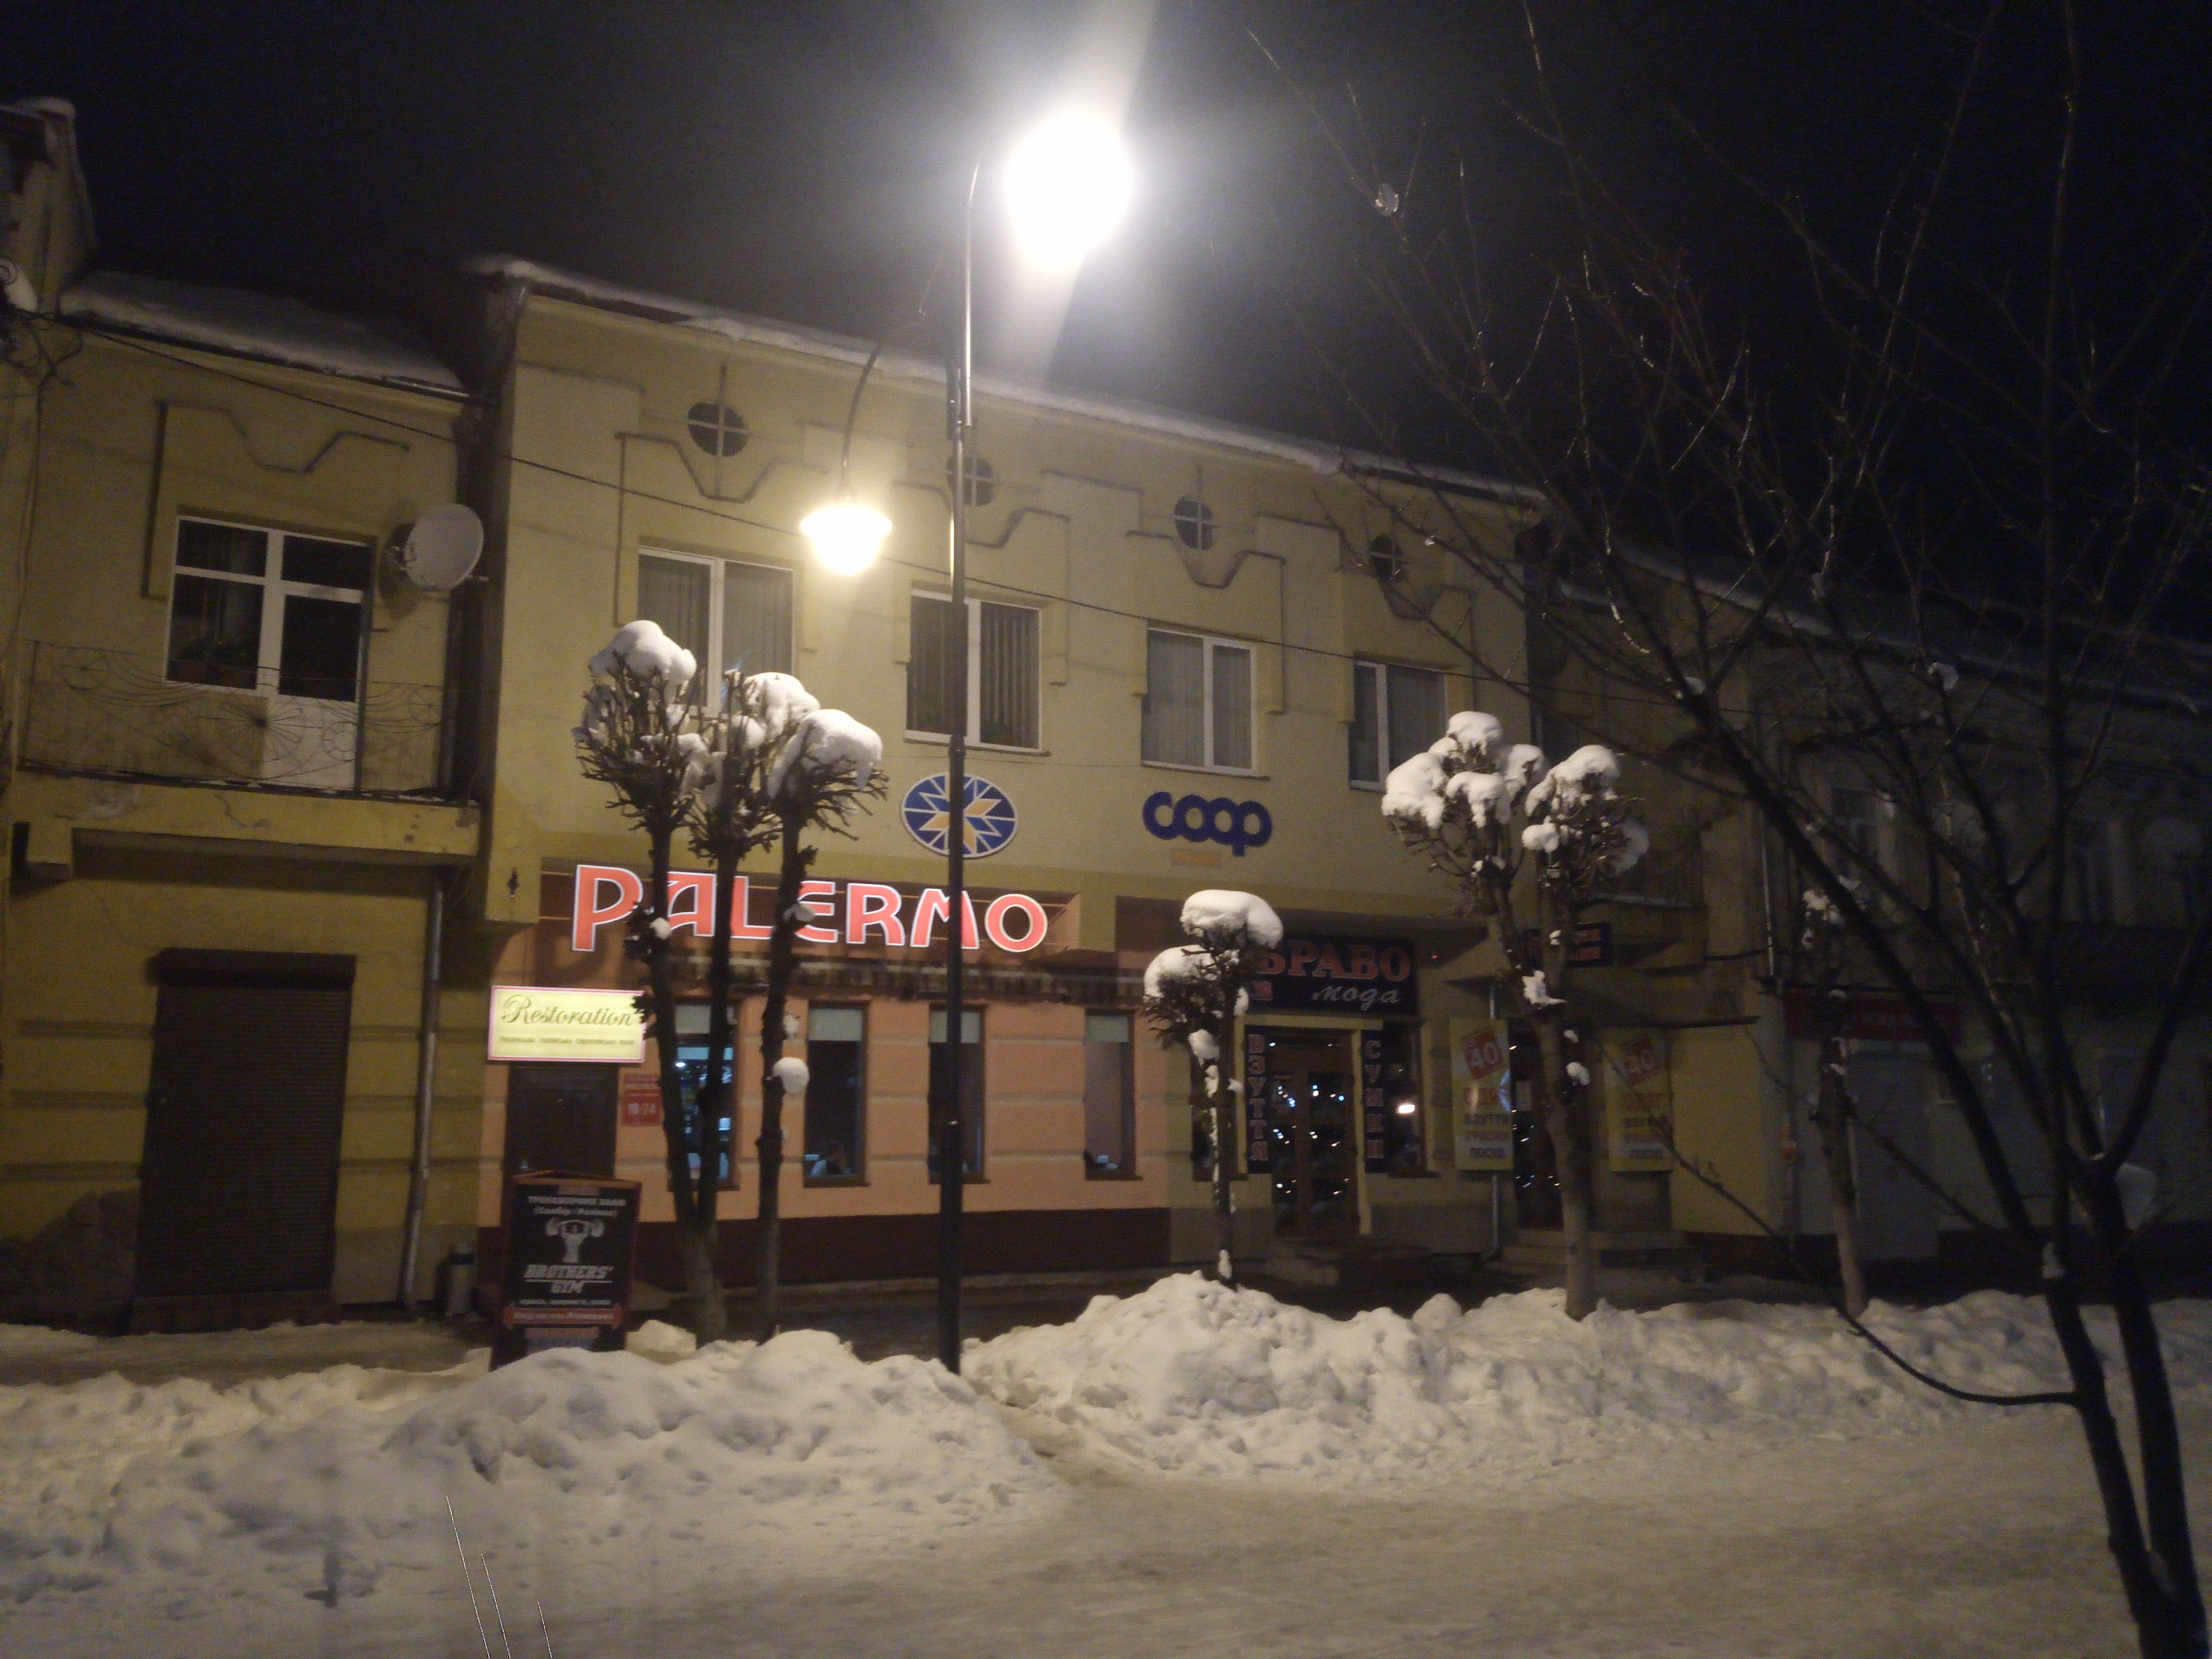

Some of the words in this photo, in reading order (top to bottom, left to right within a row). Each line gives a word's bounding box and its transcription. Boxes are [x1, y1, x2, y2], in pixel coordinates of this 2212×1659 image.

[1142, 791, 1273, 857] coop
[572, 864, 1048, 952] PALERMO
[501, 994, 632, 1026] Restoration
